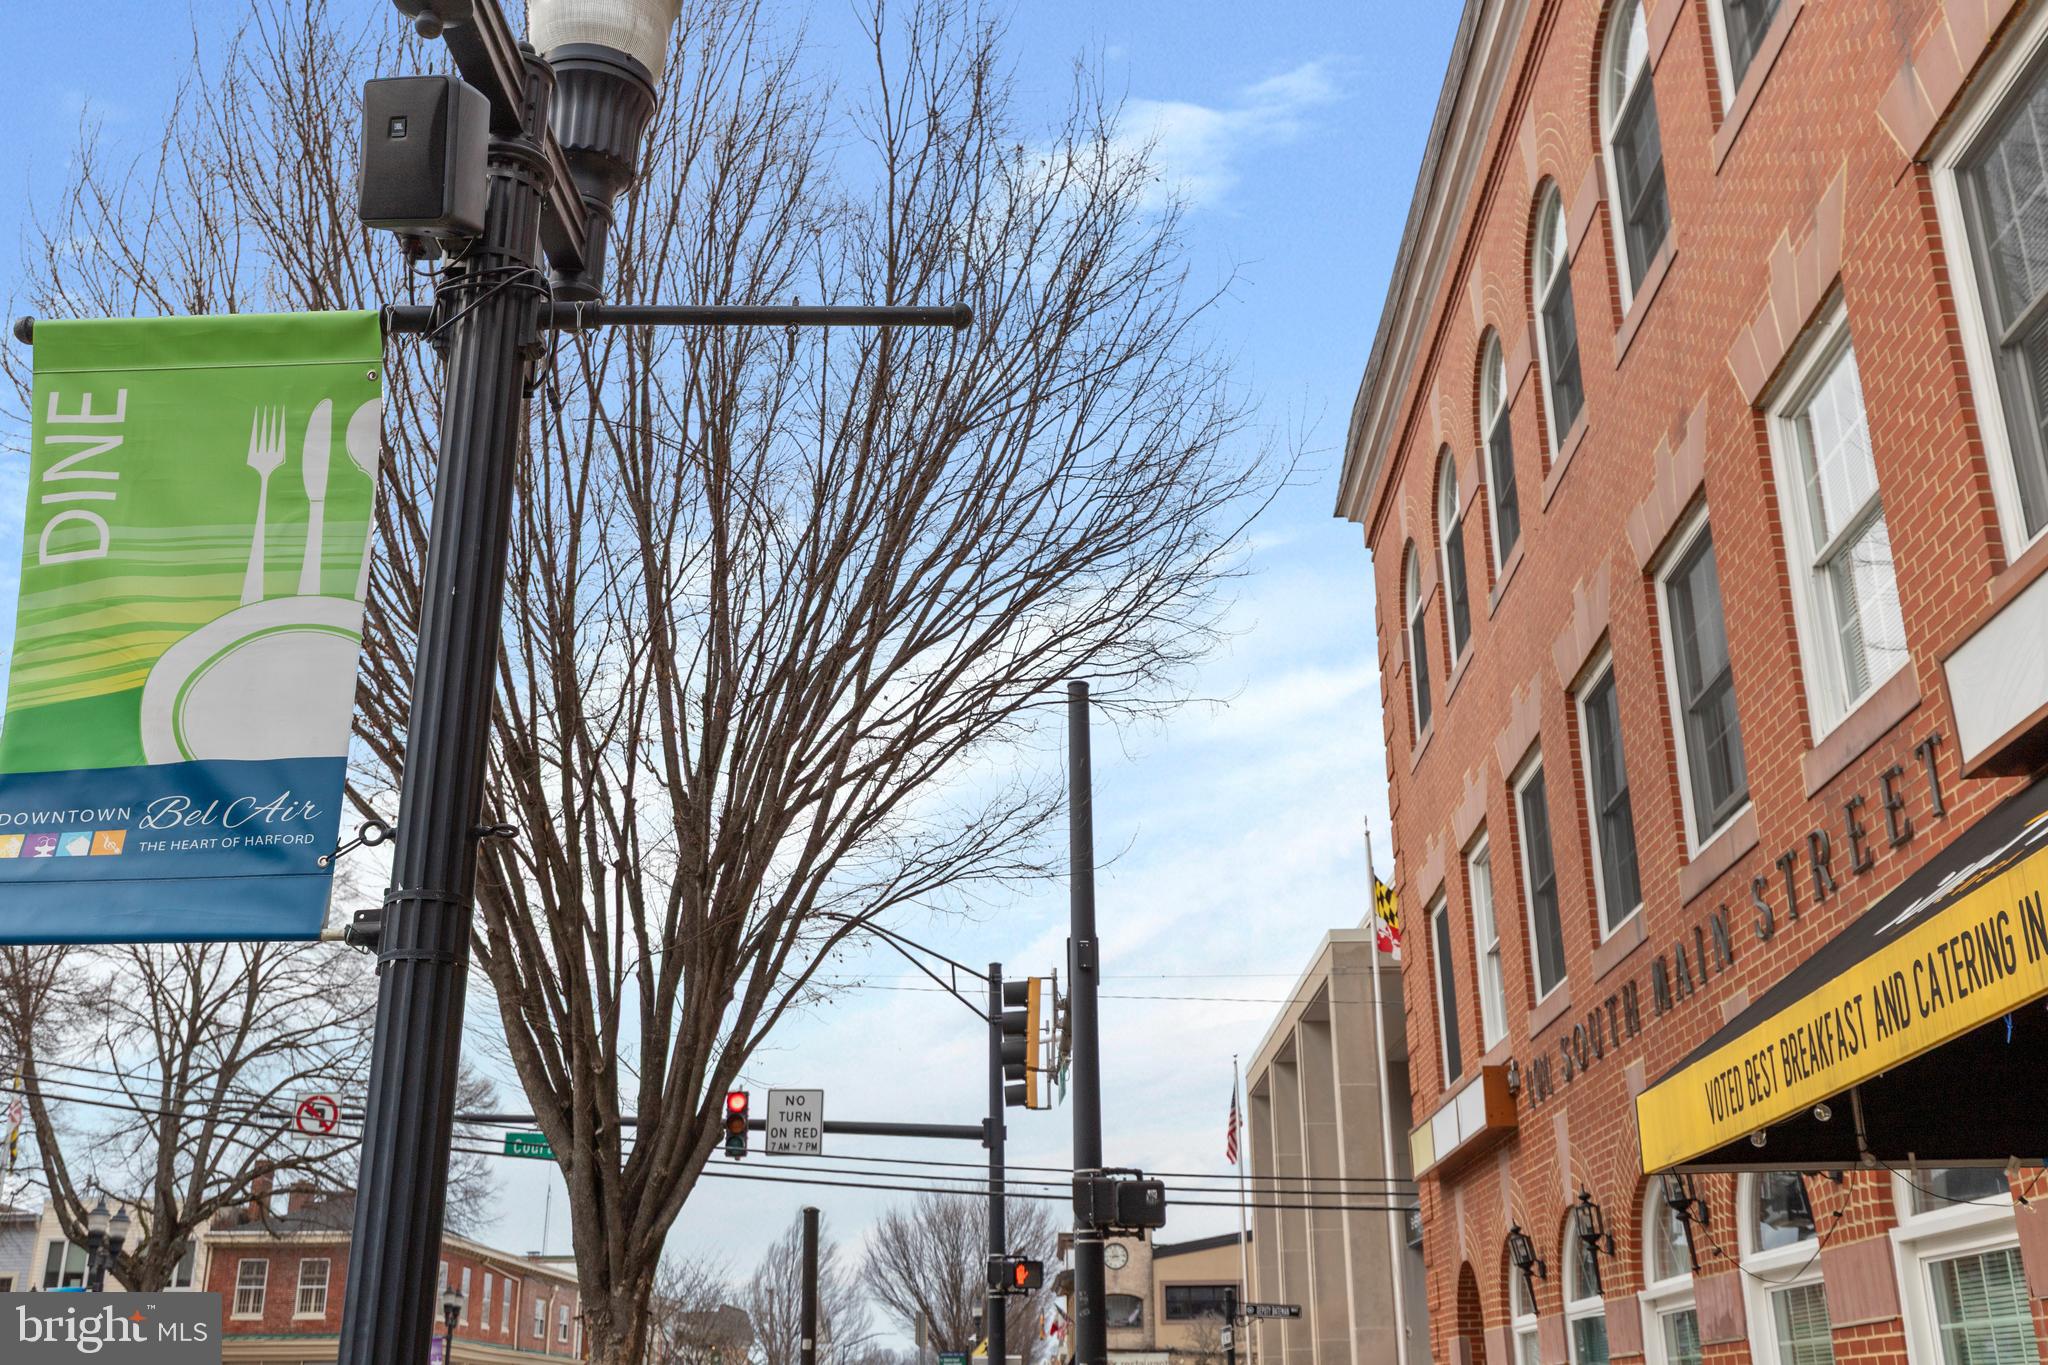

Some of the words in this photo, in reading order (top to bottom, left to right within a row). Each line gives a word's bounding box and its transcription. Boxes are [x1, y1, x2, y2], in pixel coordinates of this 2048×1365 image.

[38, 388, 128, 566] DINE
[0, 807, 131, 826] DOWNTOWN
[139, 795, 219, 830] Bel
[222, 790, 323, 830] Air
[139, 841, 167, 852] THE
[170, 838, 219, 851] HEART
[221, 837, 241, 848] OF
[244, 833, 315, 847] HARFORD
[1560, 979, 1641, 1083] SOUTH
[1651, 904, 1734, 1017] MAIN
[1750, 731, 1947, 941] STREET
[1704, 1065, 1745, 1125] VOTED
[1744, 1045, 1779, 1107] BEST
[1780, 994, 1868, 1088] BREAKFAST
[1873, 970, 1912, 1042] AND
[1912, 910, 2017, 1019] CATERING
[2018, 889, 2048, 964] IN
[785, 1095, 806, 1106] NO
[779, 1111, 811, 1122] TURN
[770, 1127, 787, 1138] ON
[794, 1127, 818, 1138] RED
[771, 1142, 777, 1151] 7
[779, 1142, 790, 1151] AM
[798, 1142, 803, 1151] 7
[805, 1142, 818, 1151] PM
